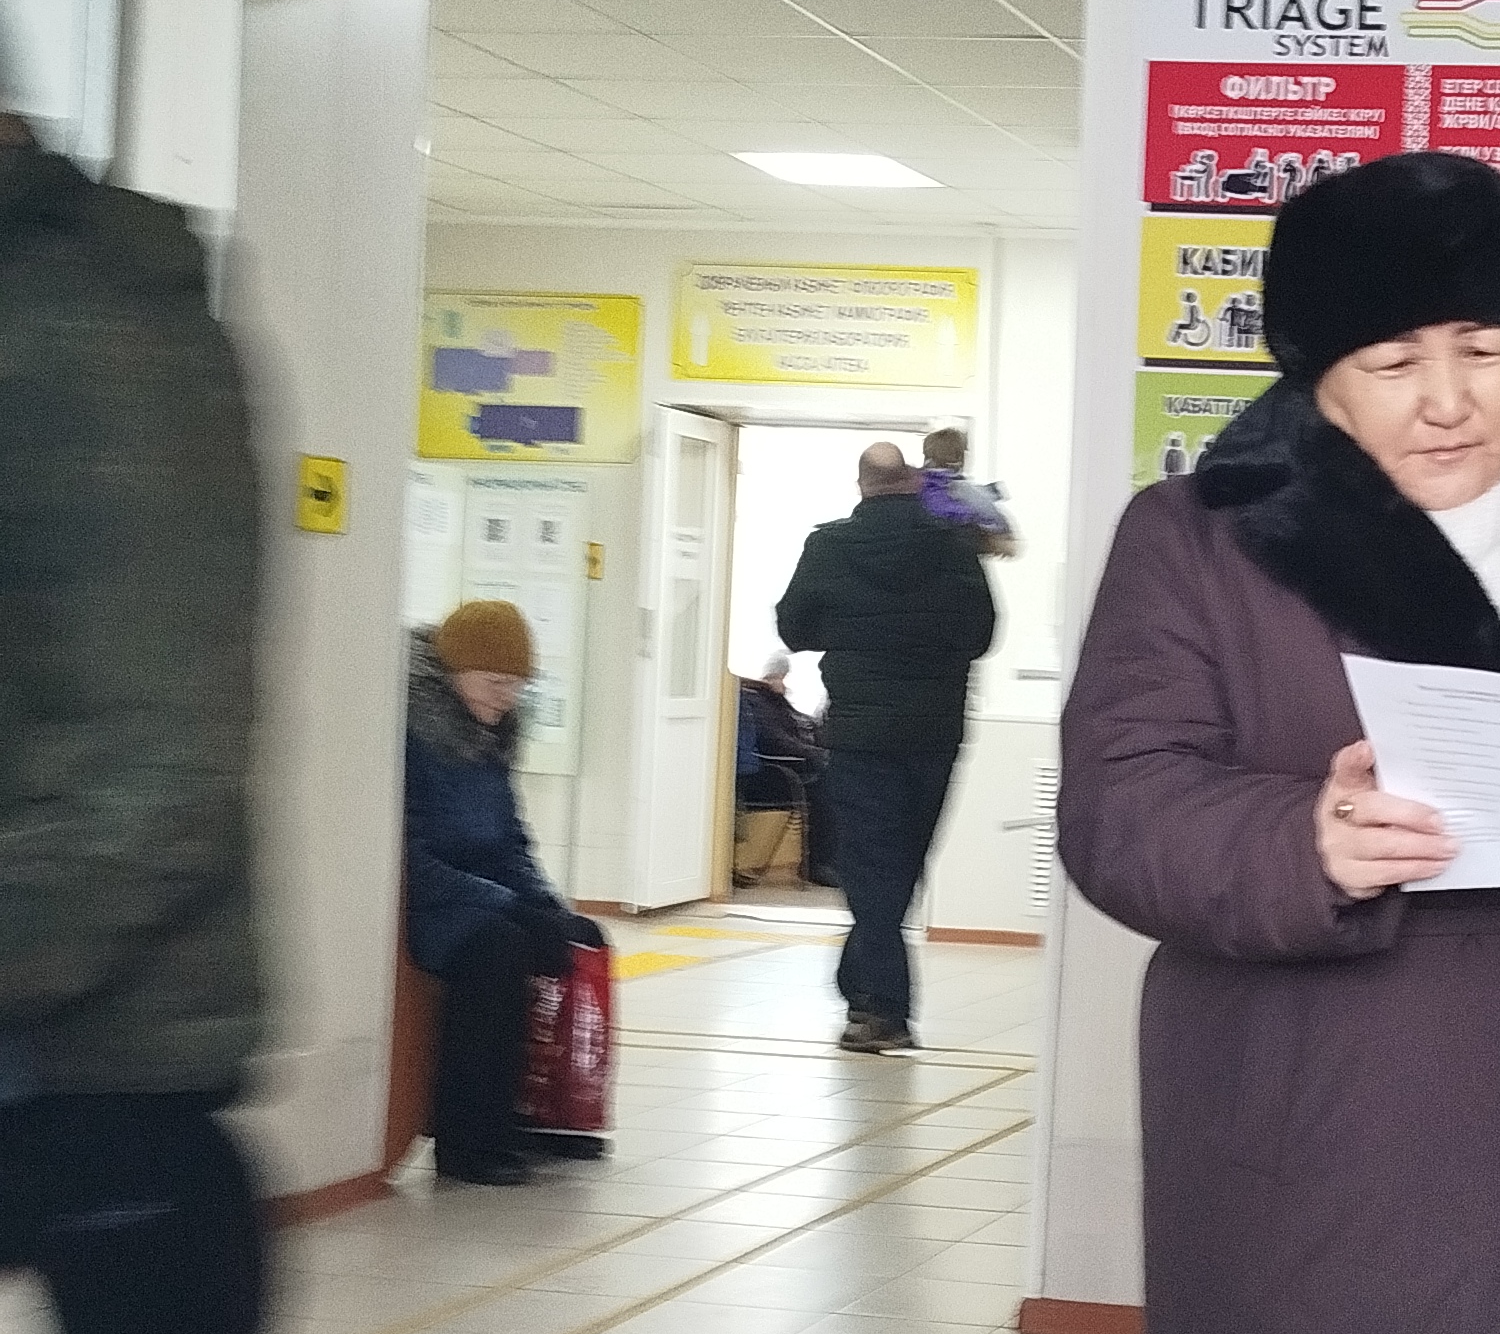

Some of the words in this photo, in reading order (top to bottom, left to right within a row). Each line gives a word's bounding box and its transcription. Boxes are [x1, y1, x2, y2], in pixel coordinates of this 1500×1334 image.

[1273, 33, 1389, 58] SYSTEM
[1219, 75, 1337, 101] ФИЛЬТР
[1440, 79, 1482, 94] ЕГЕР
[1440, 96, 1486, 113] ДЕНЕ
[1164, 396, 1253, 419] ҚАБАТТА
